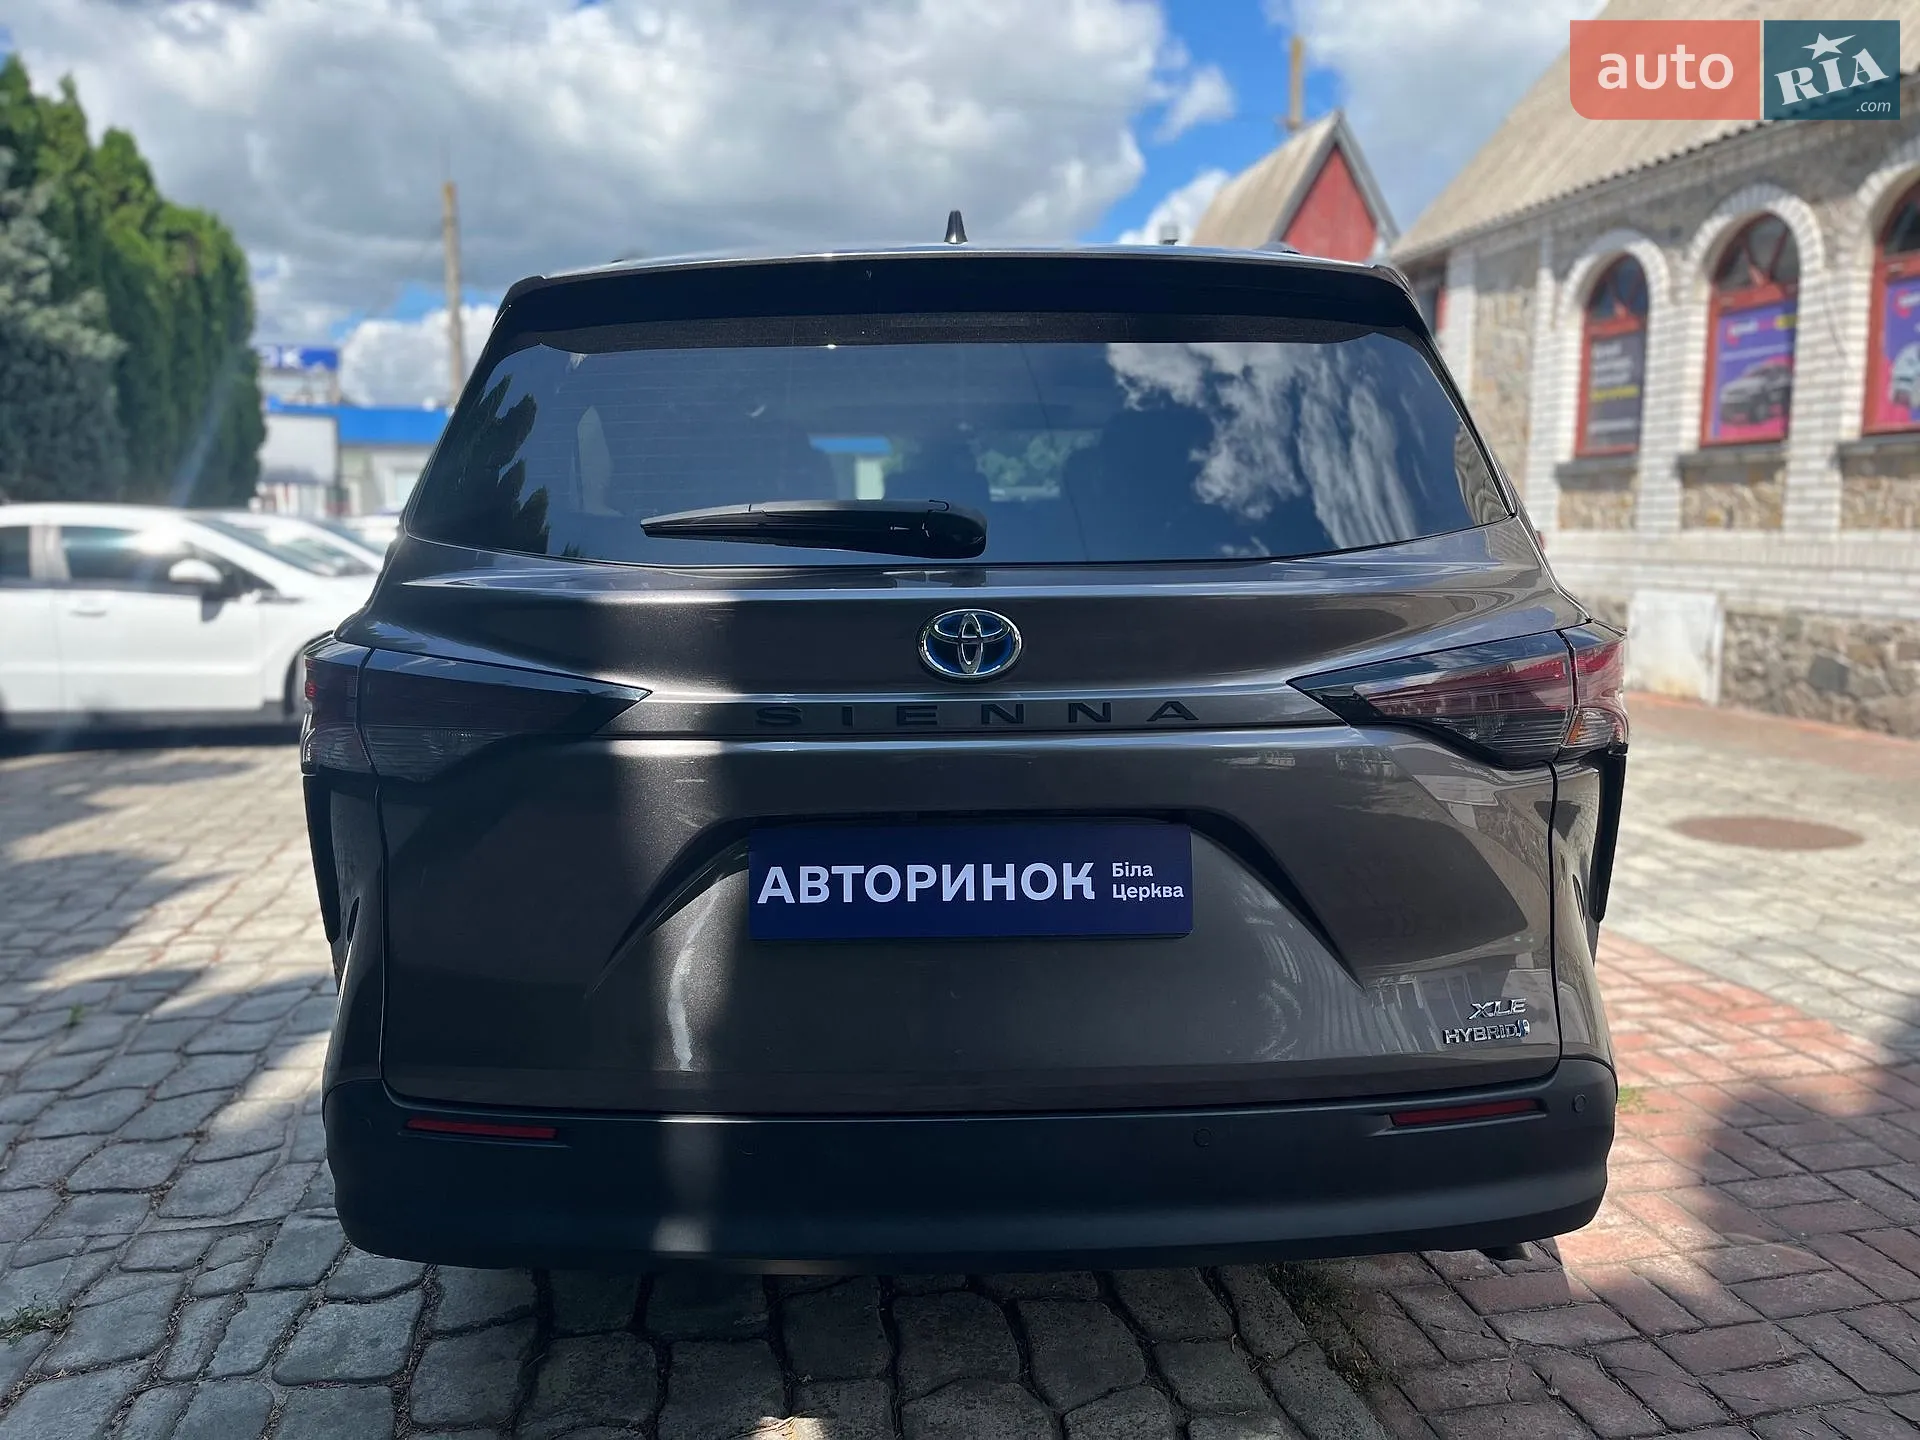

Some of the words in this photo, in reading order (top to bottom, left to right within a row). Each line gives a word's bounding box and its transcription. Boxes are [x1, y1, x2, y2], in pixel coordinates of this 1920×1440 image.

[755, 700, 1199, 727] SIENNA
[1112, 862, 1154, 877] Біла
[757, 862, 1095, 904] АВТОРИНОК
[1112, 882, 1185, 901] Церква
[1468, 998, 1527, 1019] XLE
[1444, 1023, 1519, 1044] HYBRID
